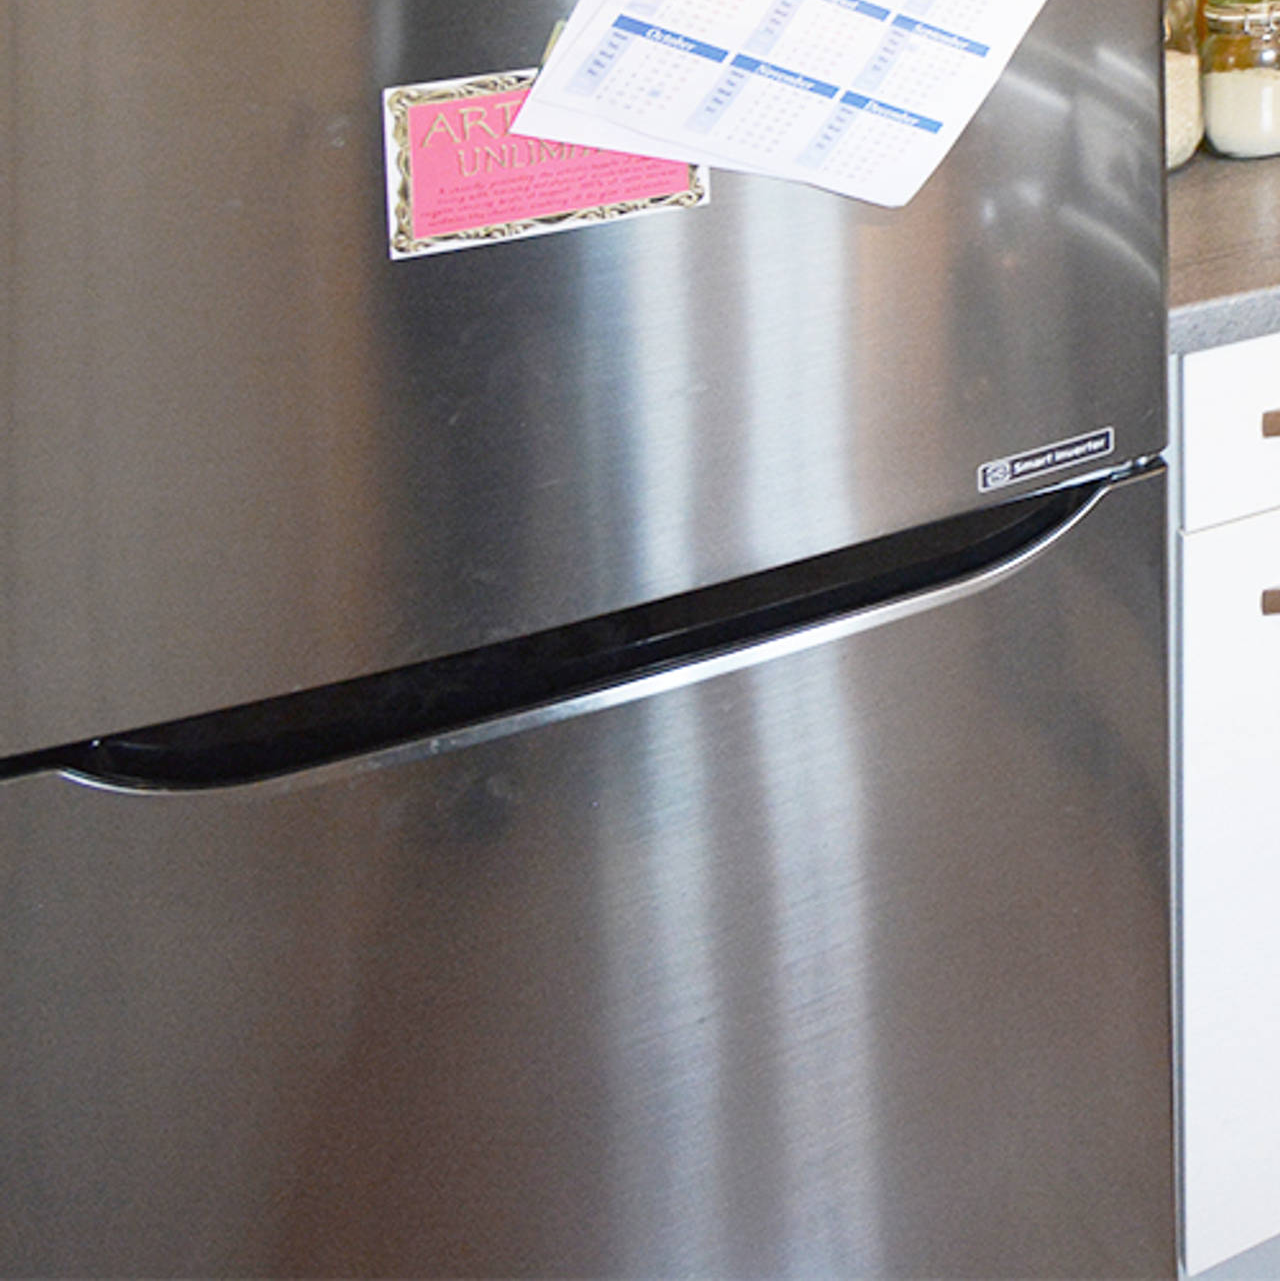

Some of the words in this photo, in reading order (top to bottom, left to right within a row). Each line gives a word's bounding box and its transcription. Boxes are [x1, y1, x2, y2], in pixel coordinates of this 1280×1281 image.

[645, 26, 698, 54] October
[756, 61, 817, 93] November
[864, 99, 920, 127] December
[1054, 437, 1105, 461] Inverter
